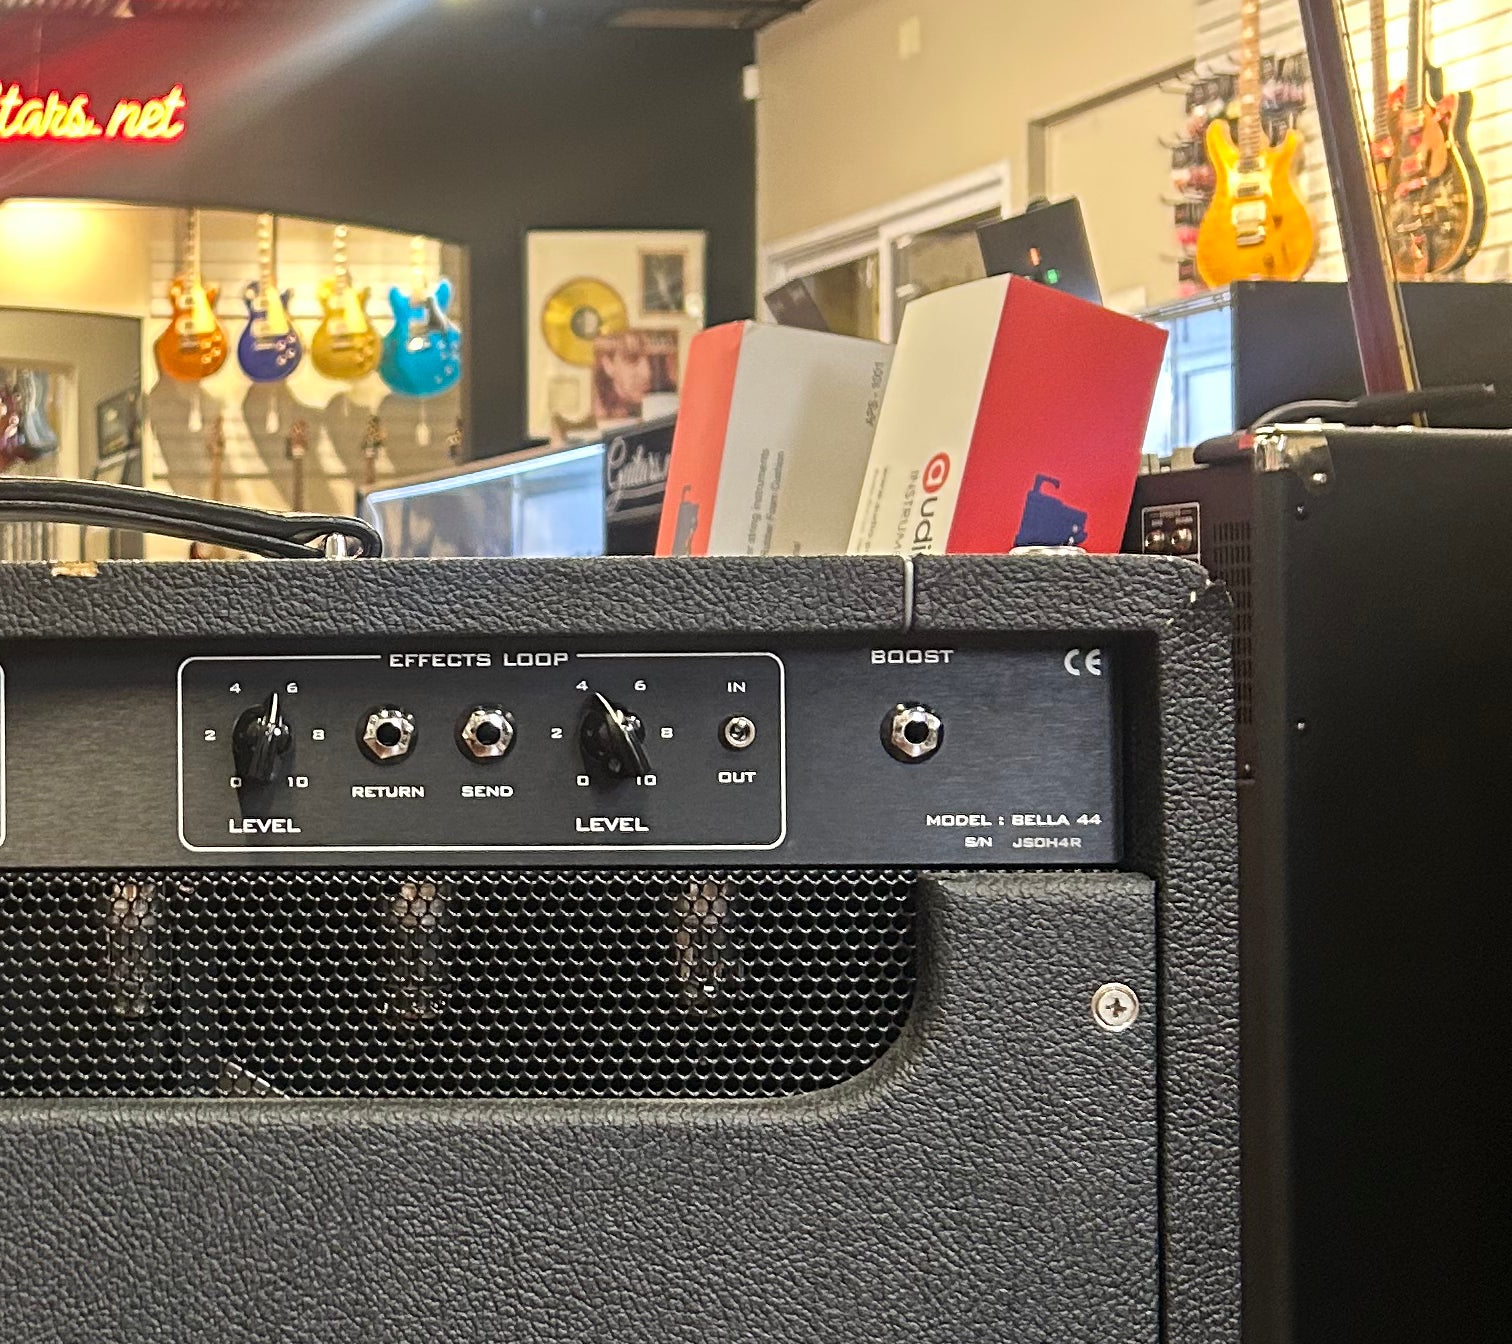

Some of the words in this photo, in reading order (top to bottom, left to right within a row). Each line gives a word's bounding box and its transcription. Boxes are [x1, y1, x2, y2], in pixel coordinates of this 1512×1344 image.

[390, 653, 491, 668] EFFECTS
[503, 652, 569, 667] LOOP
[871, 649, 954, 664] BOOST
[1064, 649, 1102, 676] CE
[229, 683, 242, 694] 4
[286, 683, 298, 694] 6
[576, 681, 589, 692] 4
[635, 681, 647, 692] 6
[727, 682, 746, 692] IN
[204, 729, 216, 741] 2
[312, 729, 325, 741] 8
[551, 727, 563, 739] 2
[661, 727, 674, 739] 8
[230, 777, 242, 788] 0
[288, 777, 309, 788] 10
[577, 775, 590, 787] 0
[636, 775, 657, 787] 10
[718, 771, 757, 783] OUT
[352, 785, 425, 798] RETURN
[461, 785, 514, 798] SEND
[576, 817, 649, 832] LEVEL
[926, 814, 992, 826] MODEL
[1011, 814, 1070, 826] BELLA
[1076, 814, 1102, 826] 44
[229, 819, 301, 834] LEVEL
[964, 836, 993, 848] S/N
